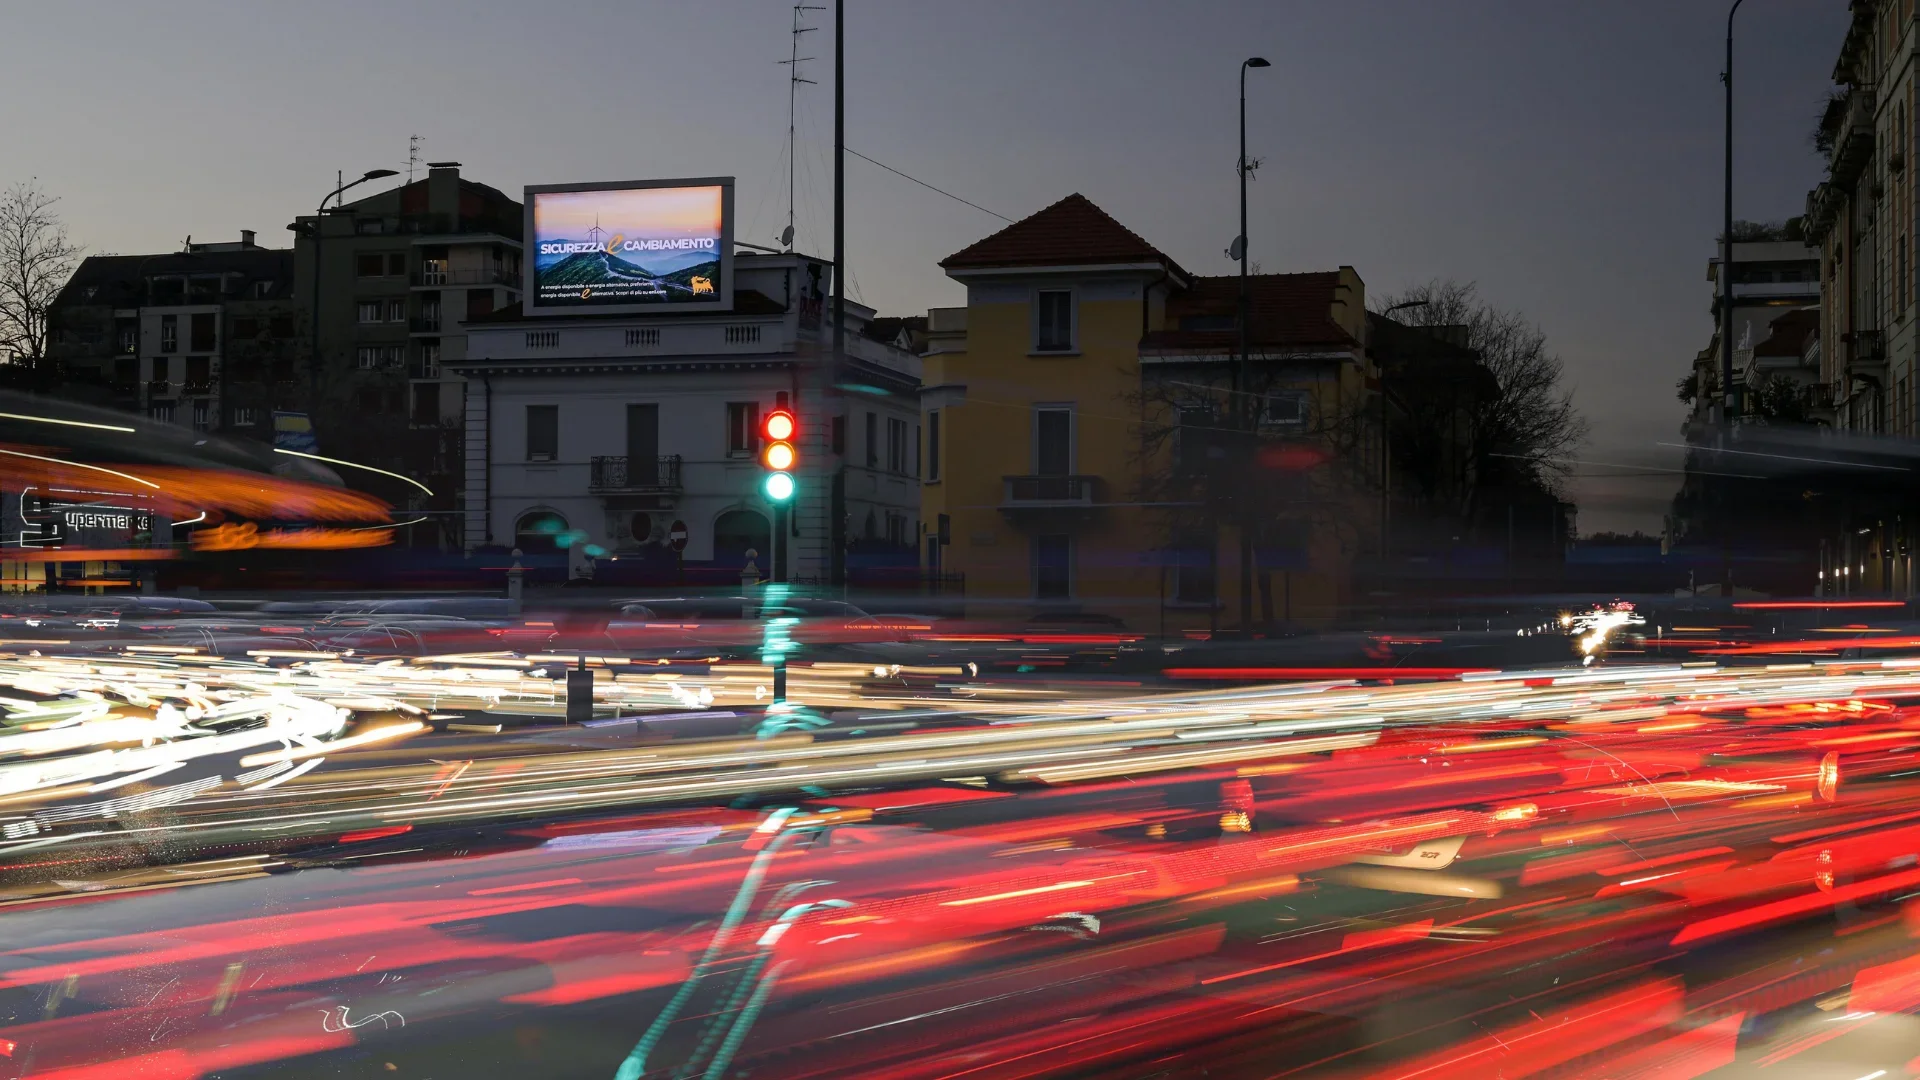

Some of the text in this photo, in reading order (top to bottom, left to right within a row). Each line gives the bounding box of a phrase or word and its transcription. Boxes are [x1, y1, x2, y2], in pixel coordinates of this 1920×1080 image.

[540, 234, 714, 255] SICUREZZA e CAMBIAMENTO
[581, 288, 592, 300] e
